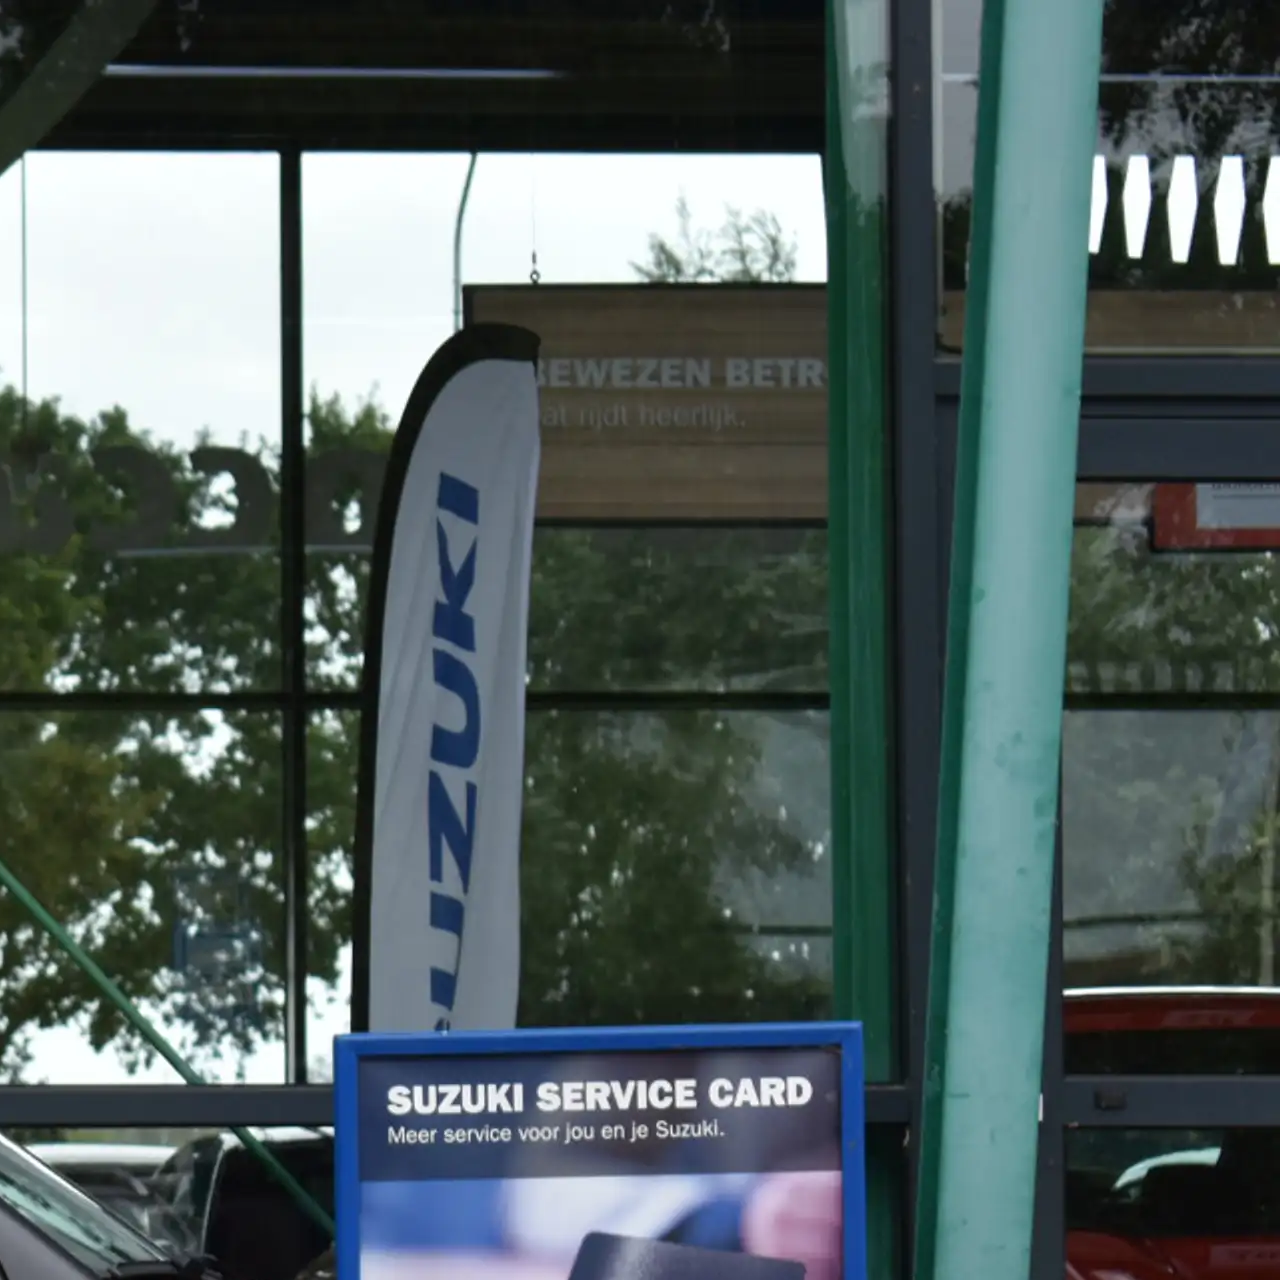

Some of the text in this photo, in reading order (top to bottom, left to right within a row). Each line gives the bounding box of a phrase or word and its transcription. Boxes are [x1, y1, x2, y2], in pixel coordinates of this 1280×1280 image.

[726, 357, 829, 388] BETR
[427, 472, 482, 1034] UZUKI
[386, 1076, 813, 1115] SUZUKI SERVICE CARD
[387, 1119, 726, 1145] Meer service voor jou en je Suzuki.
